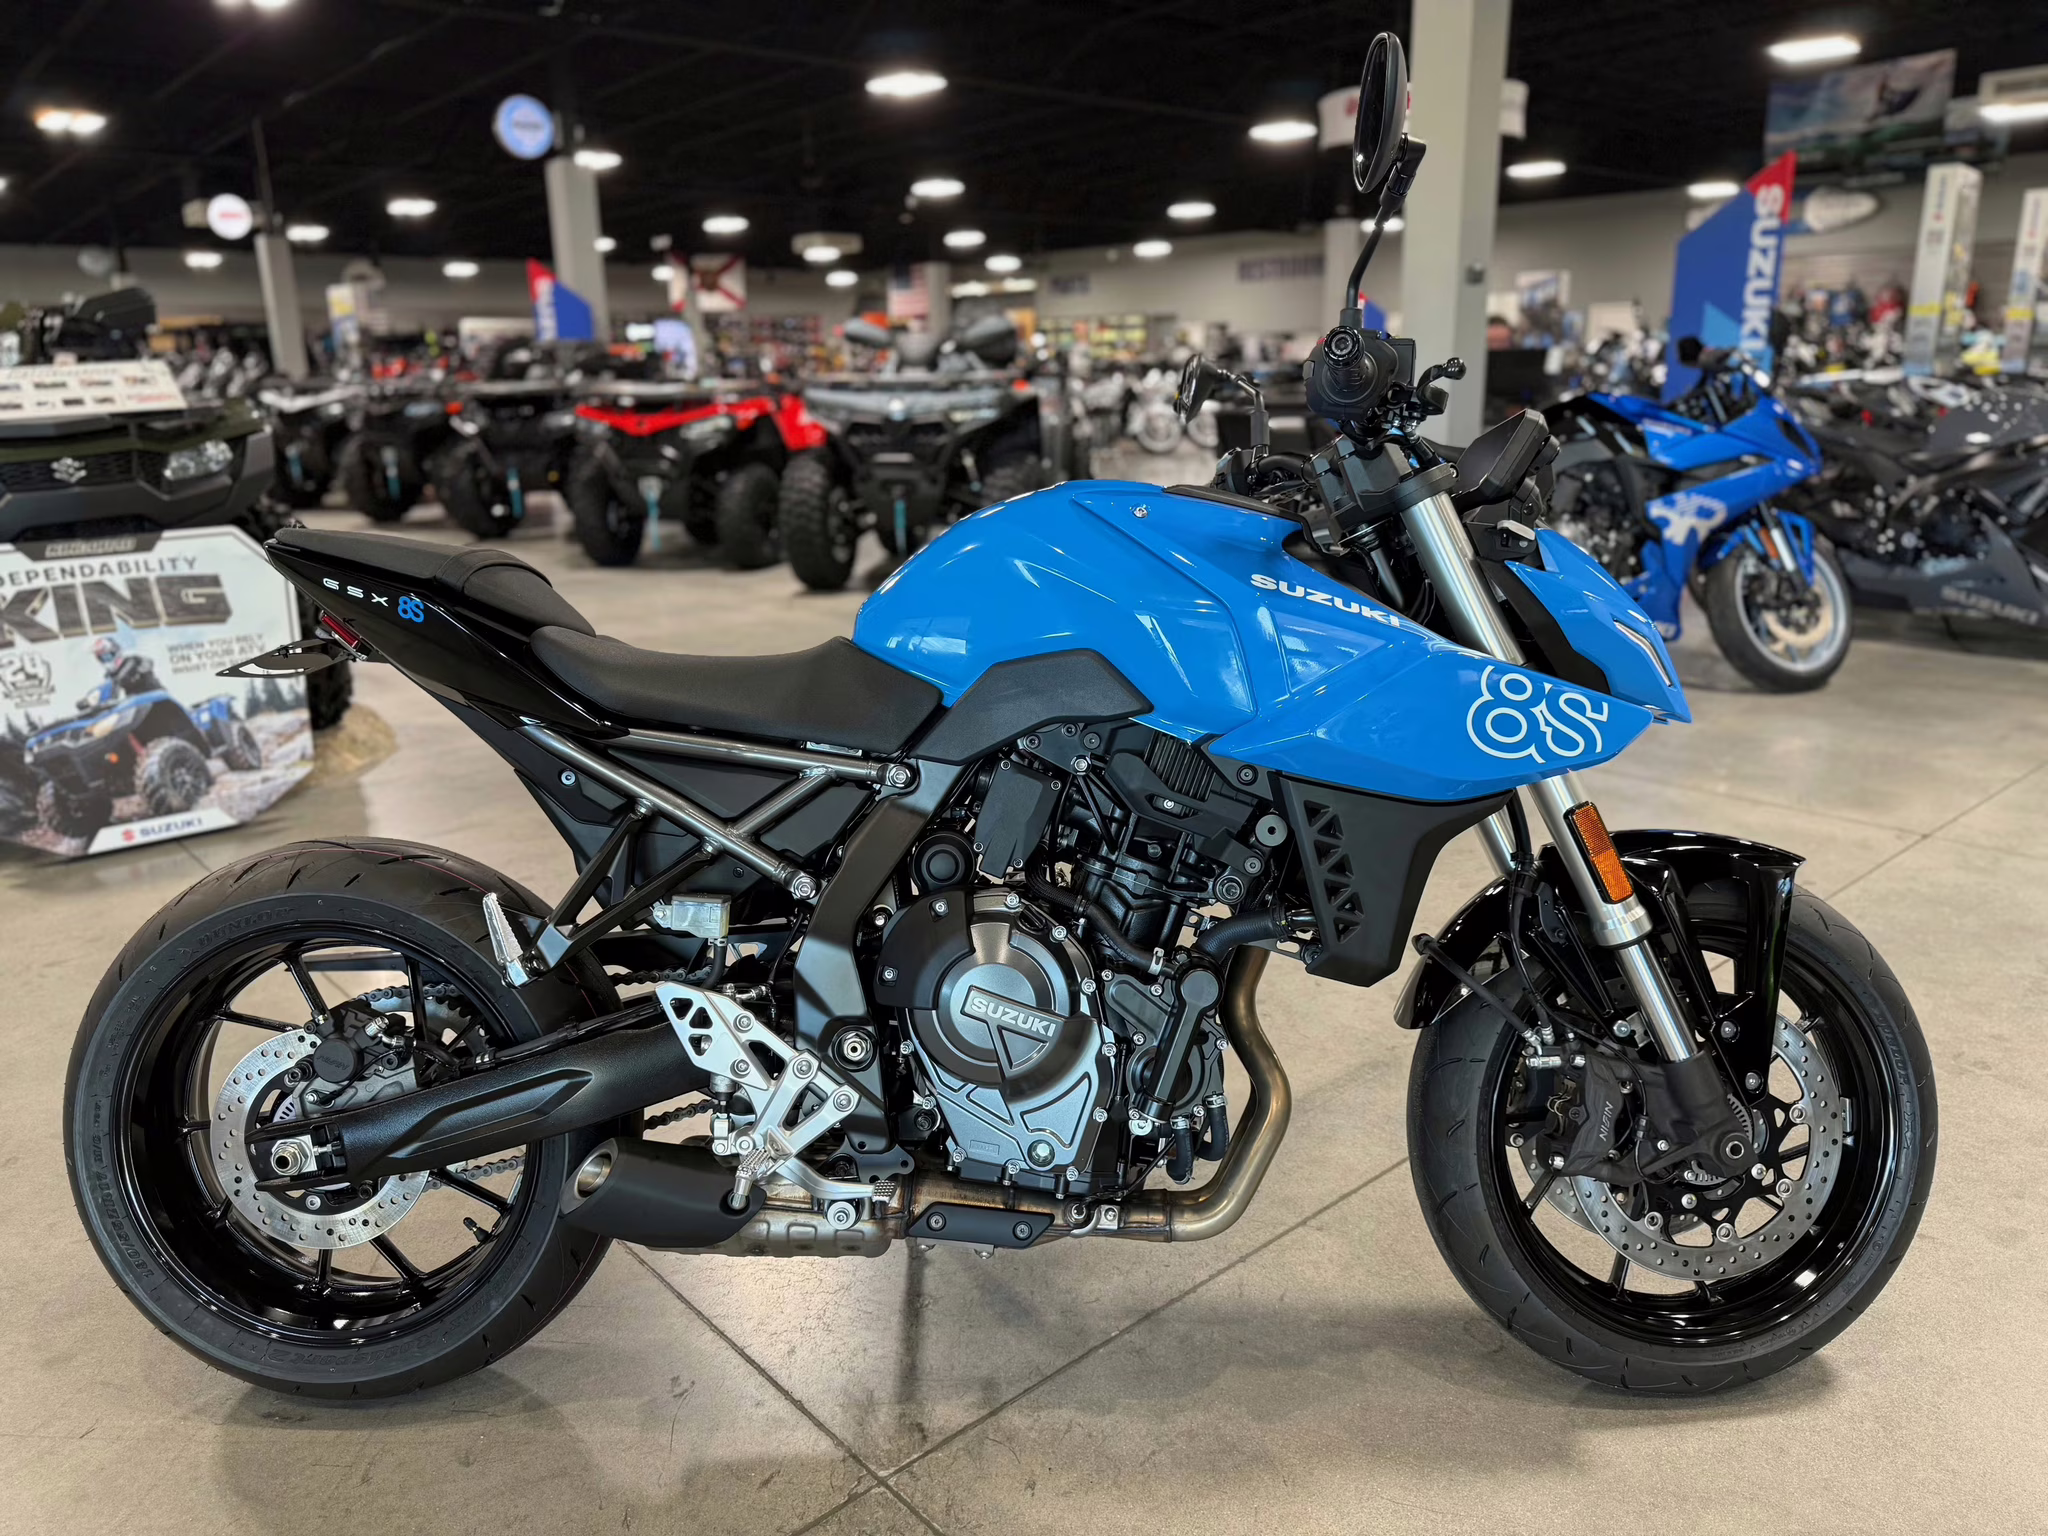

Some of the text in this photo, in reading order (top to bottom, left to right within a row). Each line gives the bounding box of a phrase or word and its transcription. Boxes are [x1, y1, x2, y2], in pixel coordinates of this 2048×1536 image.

[1740, 183, 1786, 350] SUZUKI
[0, 574, 232, 649] KING
[397, 595, 424, 623] 8S
[1251, 573, 1400, 628] SUZUKI
[139, 817, 203, 838] SUZUKI
[970, 996, 1057, 1037] SUZUKI
[95, 1170, 155, 1279] 180/55ZR17
